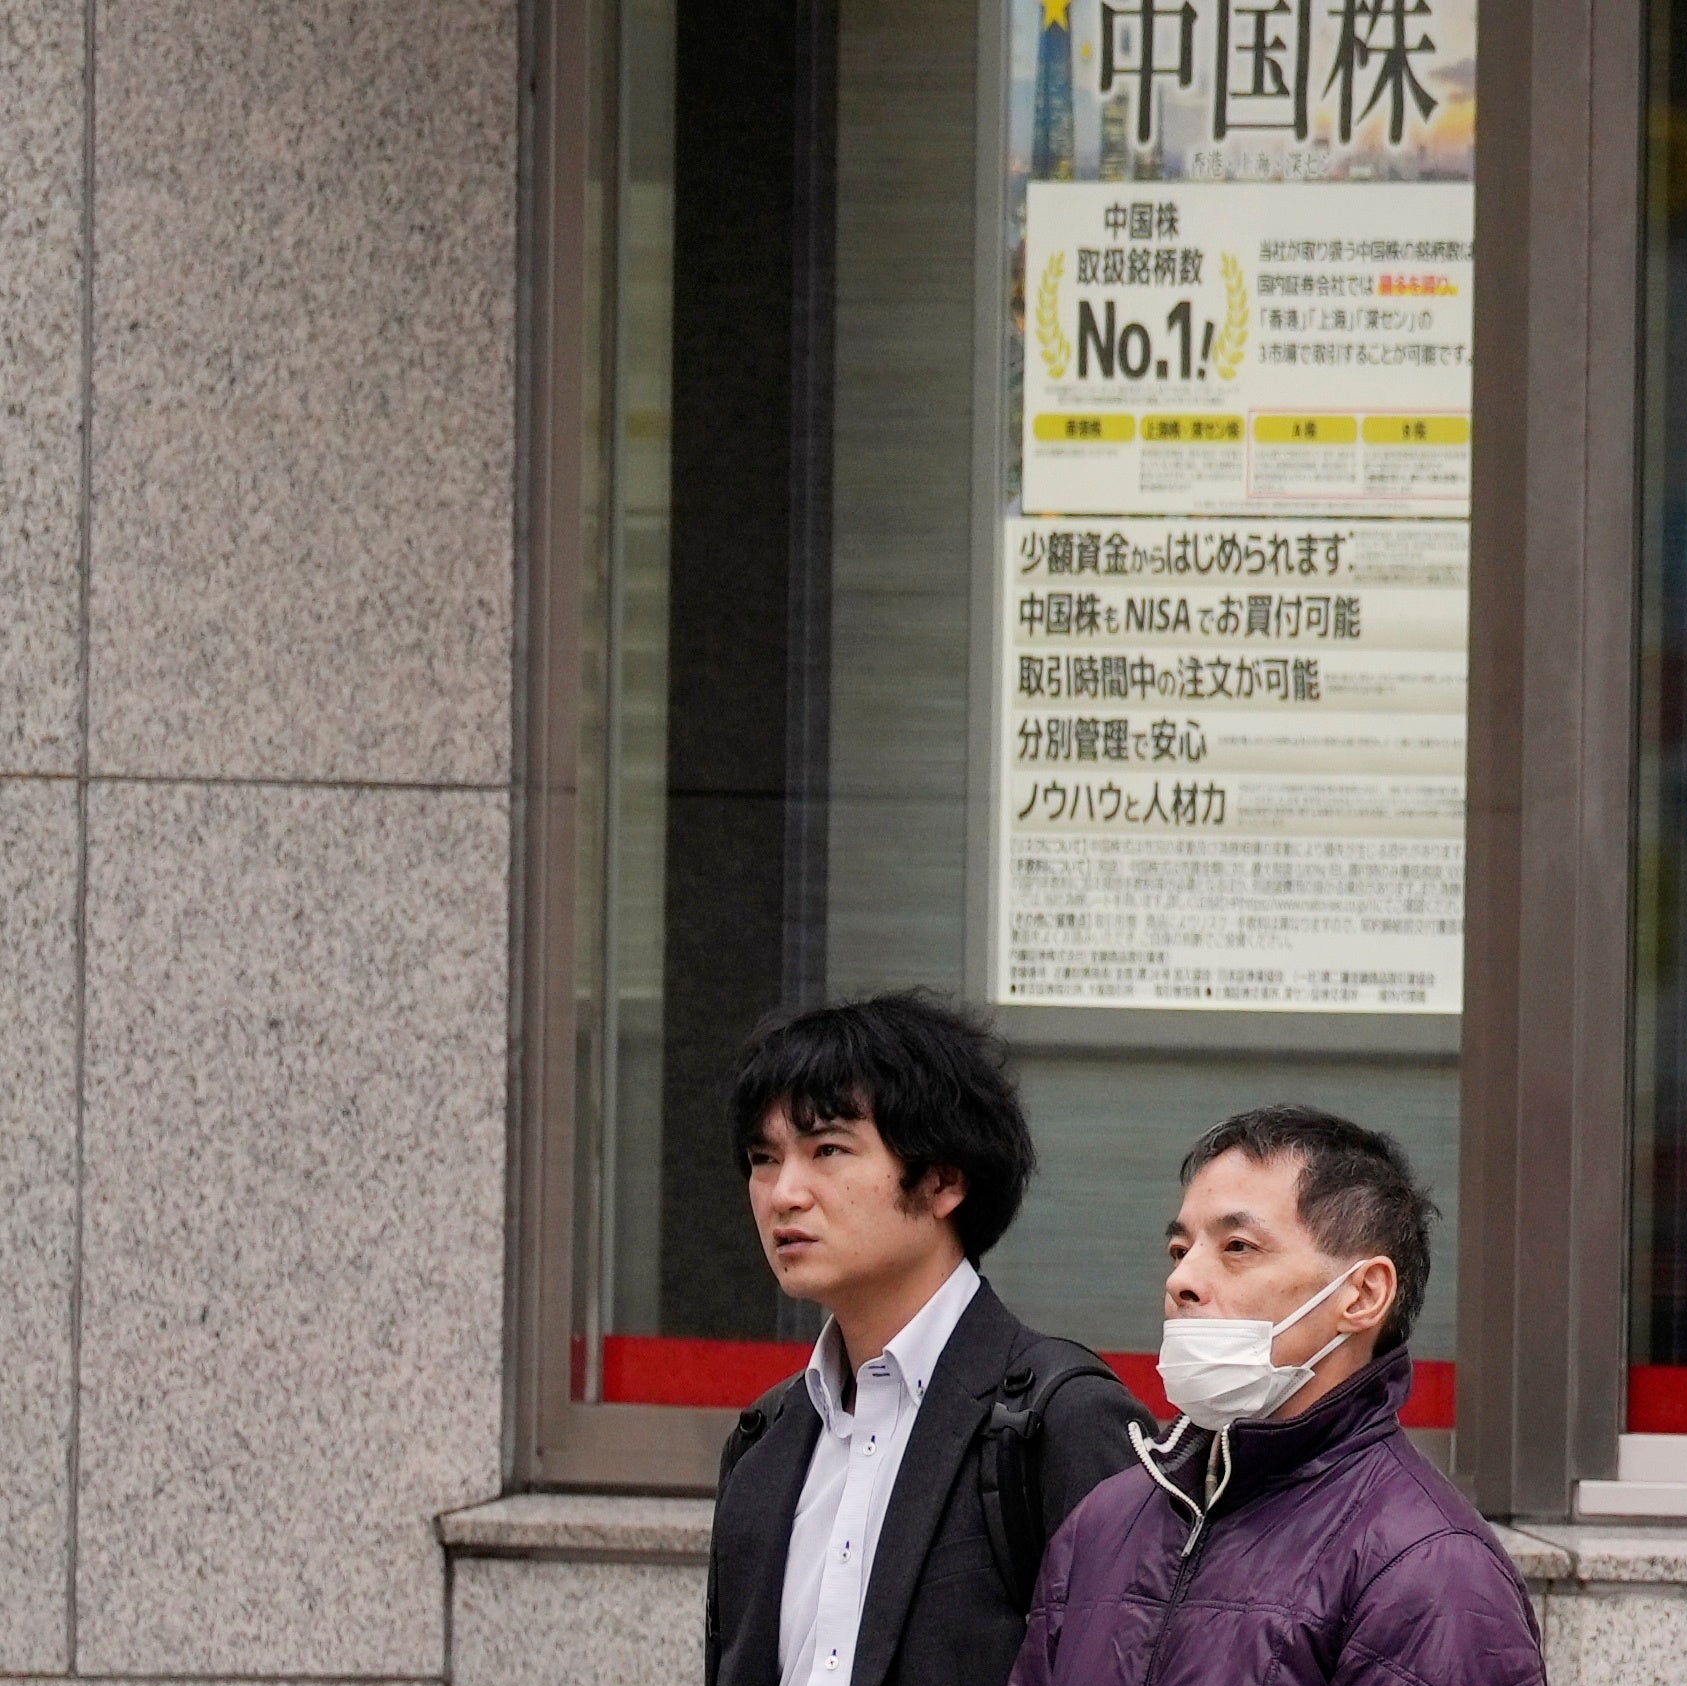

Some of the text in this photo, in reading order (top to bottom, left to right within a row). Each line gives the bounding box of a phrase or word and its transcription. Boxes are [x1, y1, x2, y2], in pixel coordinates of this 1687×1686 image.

[1101, 0, 1438, 143] 中国株
[1104, 201, 1179, 240] 中国株
[1077, 247, 1204, 286] 取扱銘柄数
[1077, 300, 1215, 380] No.1!
[1021, 532, 1347, 577] 少額資金からはじめられます
[1018, 654, 1321, 702] 取引時間中の注文が可能
[1018, 716, 1208, 763] 分別管理で安心
[1017, 779, 1226, 826] ノウハウと人材力
